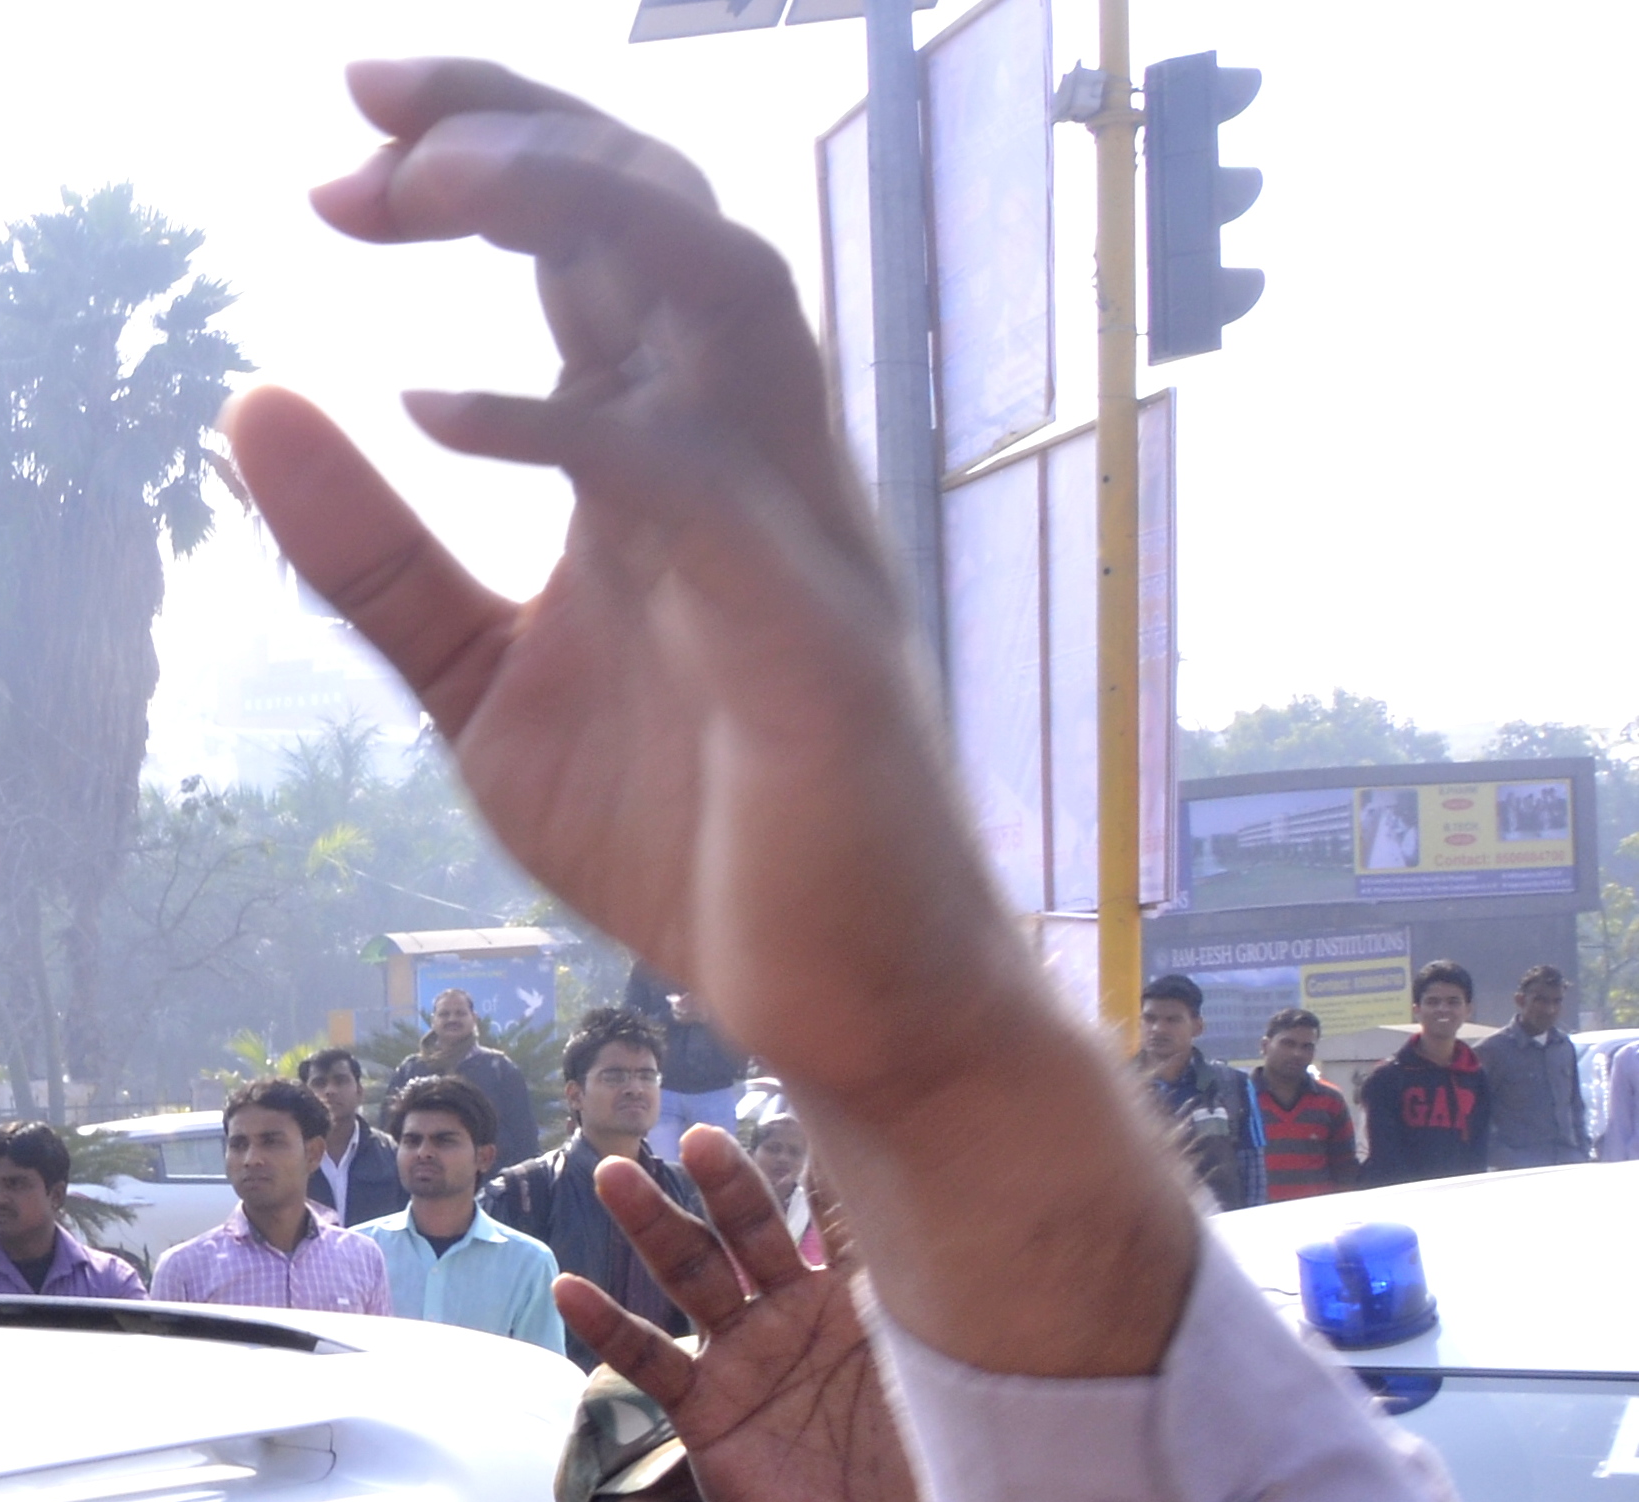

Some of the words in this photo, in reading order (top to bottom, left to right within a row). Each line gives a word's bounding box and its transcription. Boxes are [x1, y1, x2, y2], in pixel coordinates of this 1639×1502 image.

[1434, 852, 1490, 867] Contact:
[1171, 943, 1233, 969] RAM-EESH
[1235, 940, 1289, 965] GROUP
[1291, 938, 1312, 960] OF
[1315, 931, 1405, 958] INSTITUTIONS
[483, 994, 500, 1013] of
[1402, 1086, 1476, 1131] GAP
